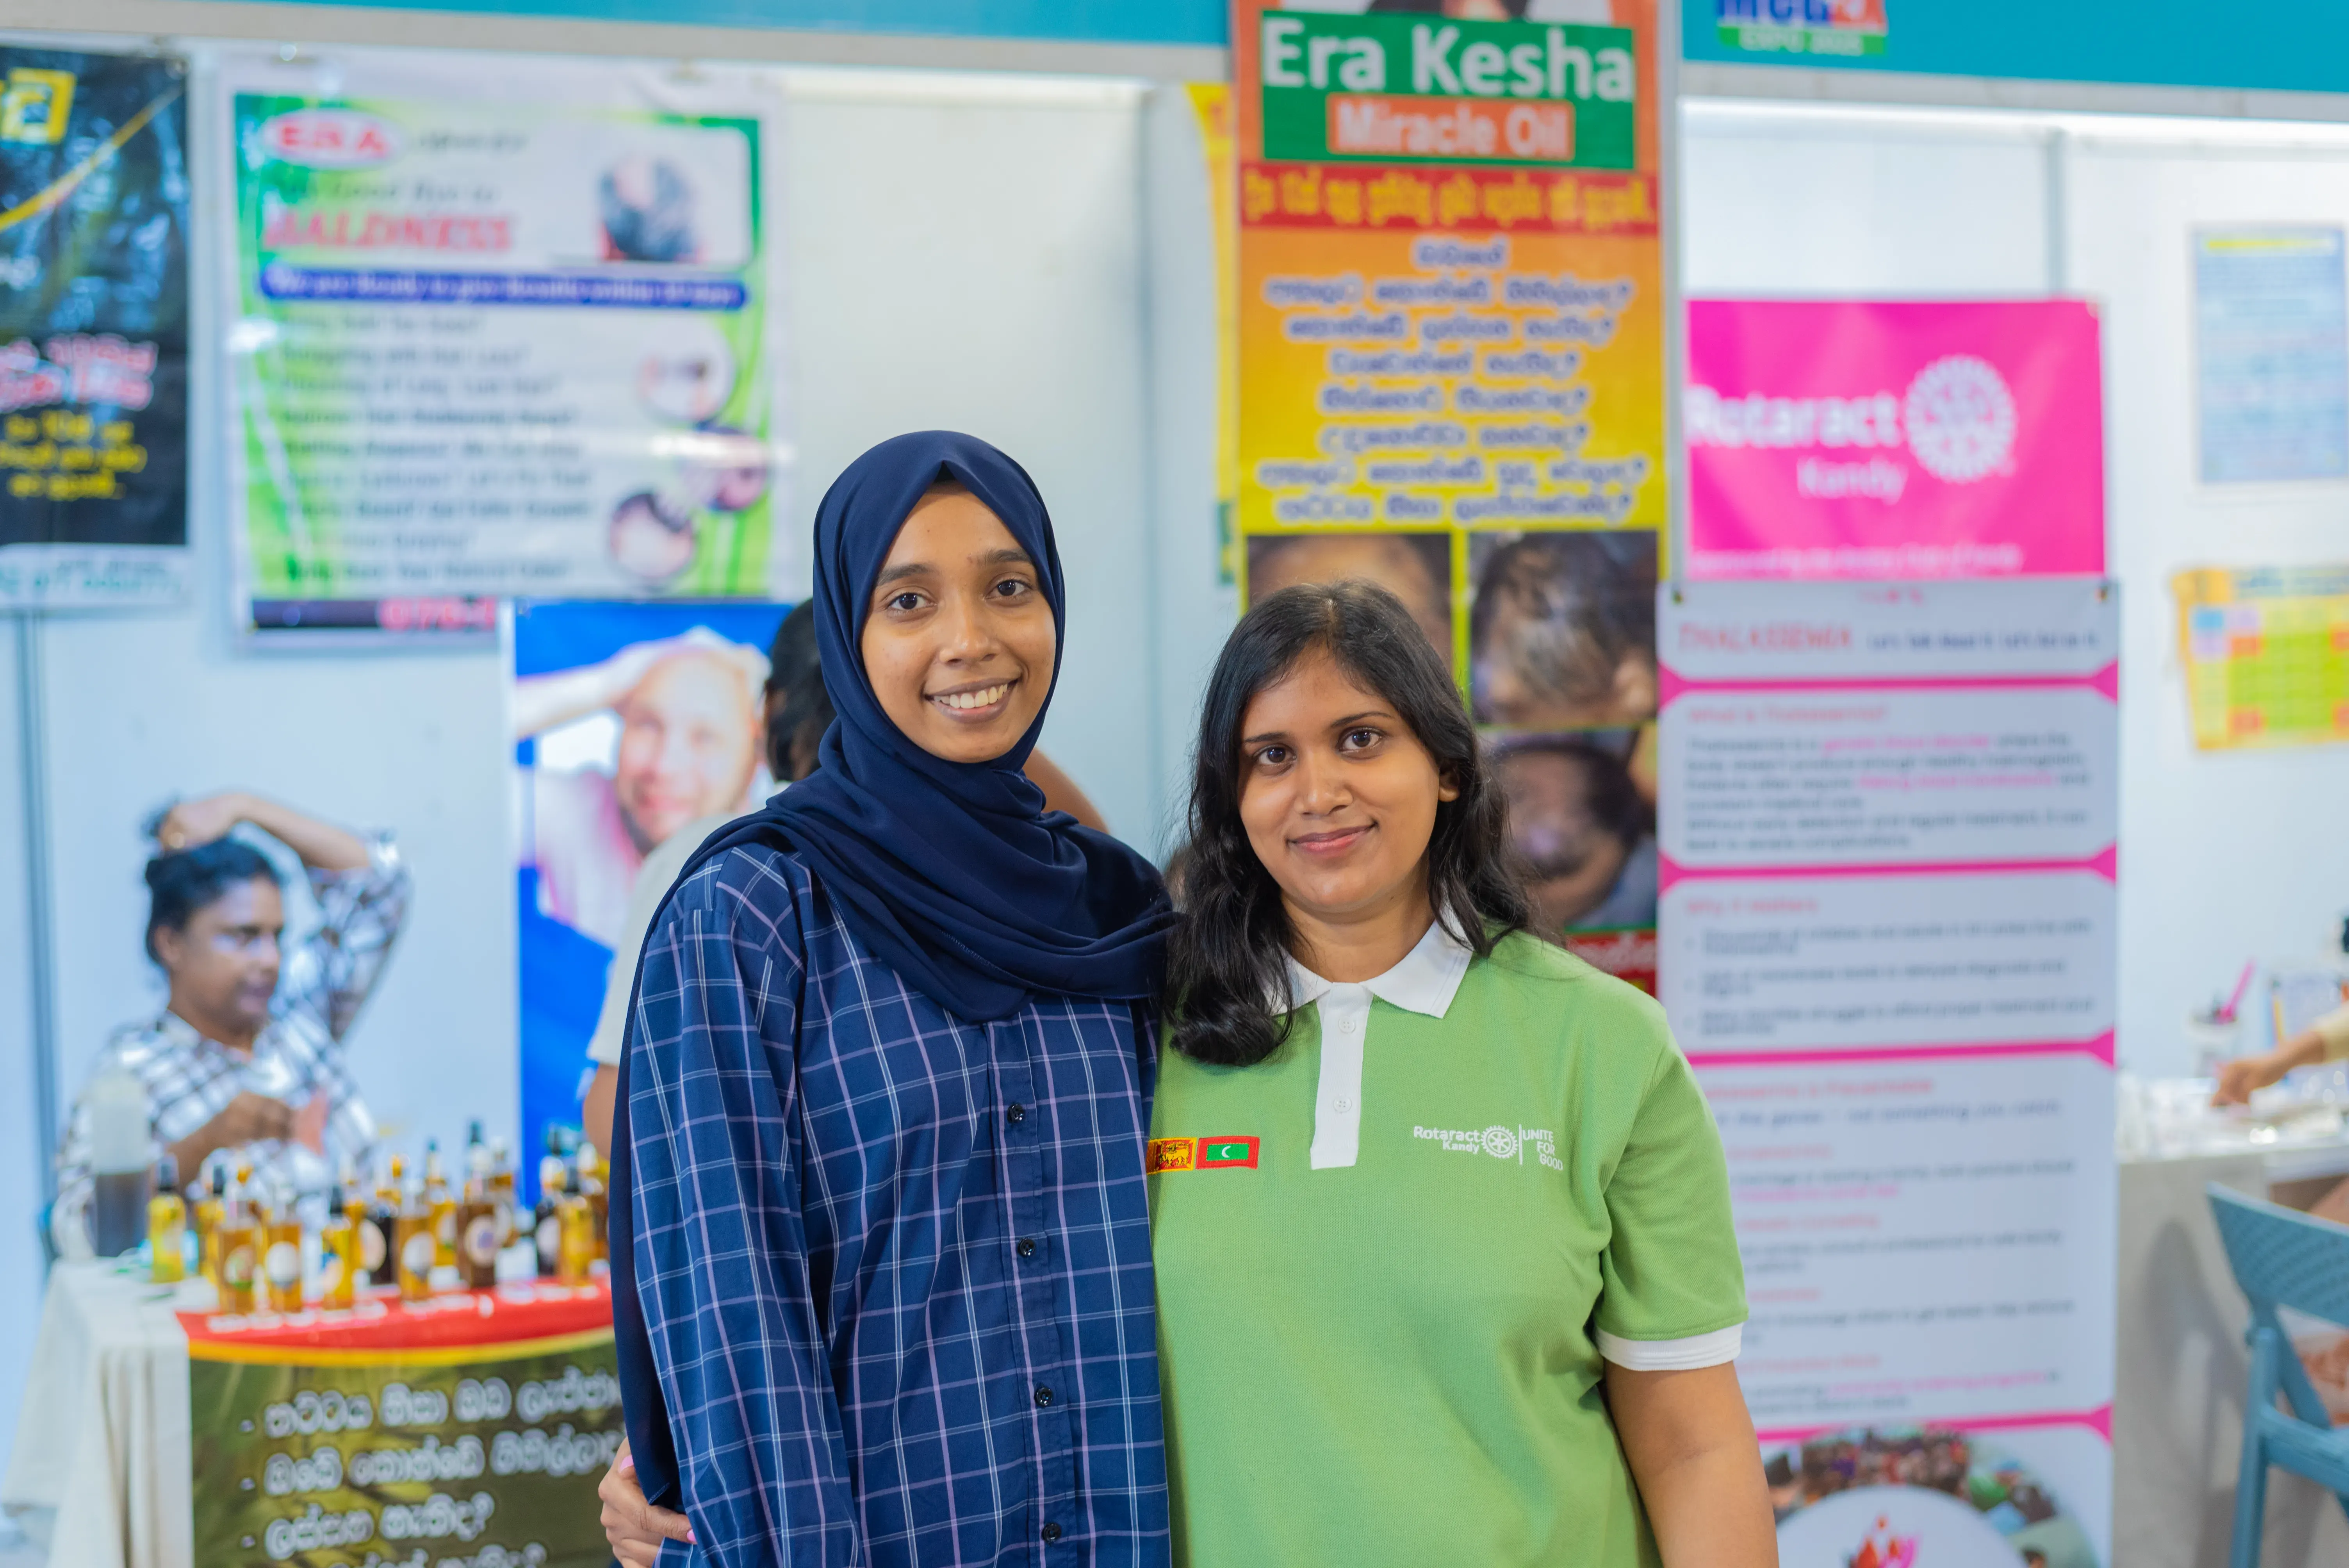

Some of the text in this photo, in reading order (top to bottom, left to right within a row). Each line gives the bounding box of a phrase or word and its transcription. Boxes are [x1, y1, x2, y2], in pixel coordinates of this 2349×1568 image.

[1262, 18, 1633, 102] Era Kesha
[1337, 103, 1570, 156] Miracle Oil
[1684, 387, 1898, 447] Rotaract
[1797, 458, 1905, 503] Kandy
[1413, 1126, 1481, 1142] Rotaract
[1522, 1129, 1554, 1142] UNITE
[1442, 1140, 1479, 1155] Kandy
[1536, 1141, 1555, 1156] FOR
[1539, 1153, 1563, 1171] GOOD
